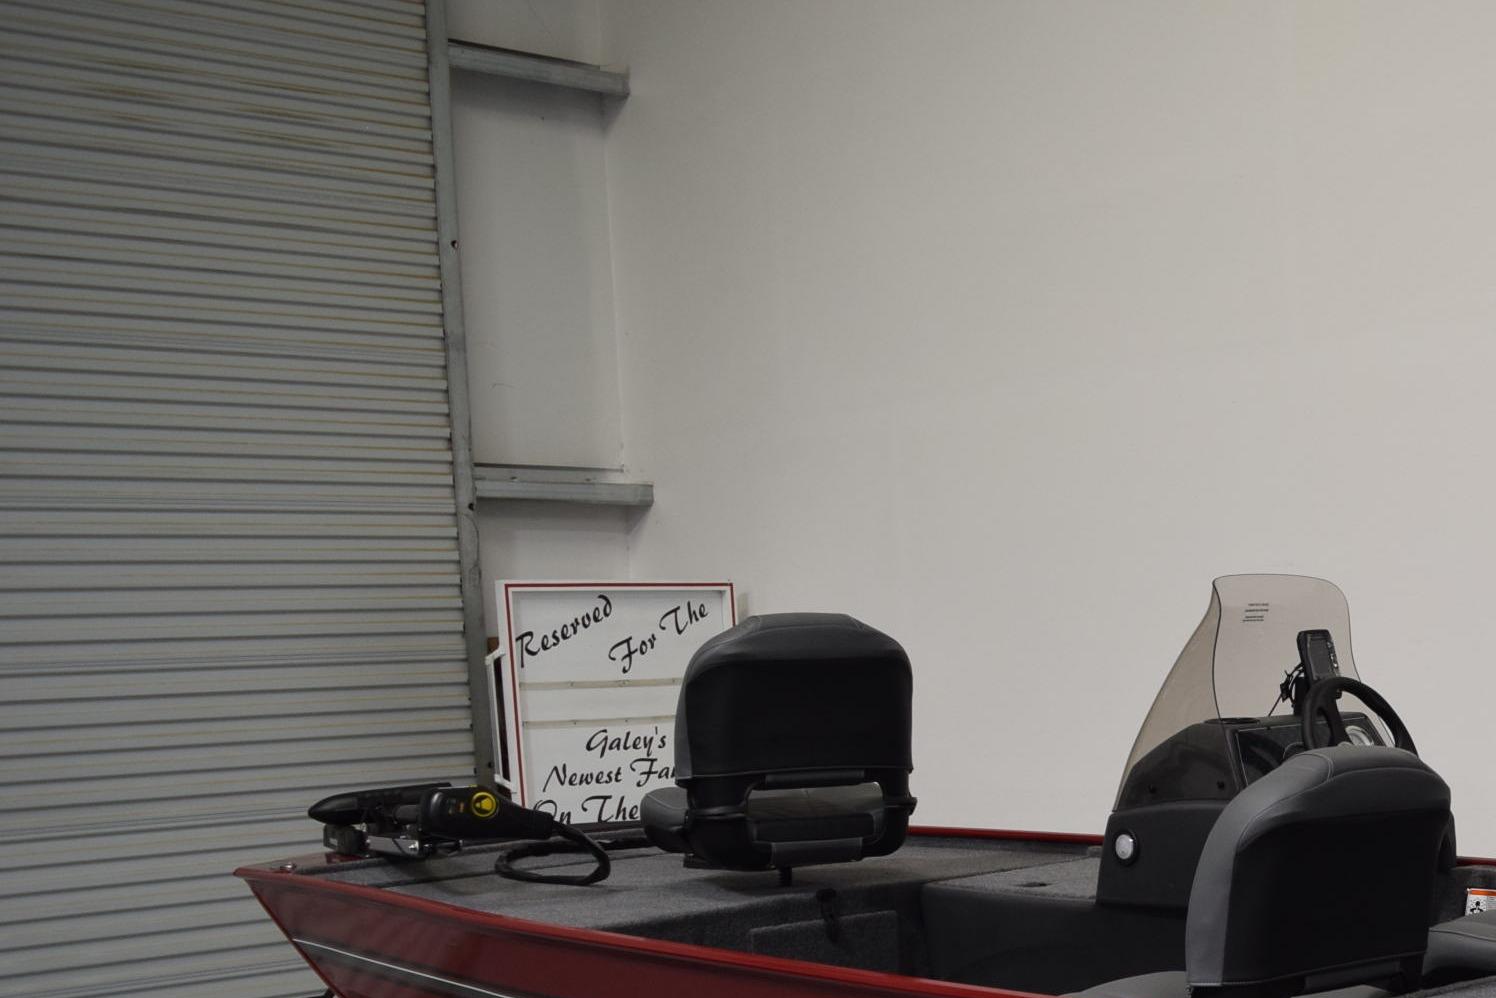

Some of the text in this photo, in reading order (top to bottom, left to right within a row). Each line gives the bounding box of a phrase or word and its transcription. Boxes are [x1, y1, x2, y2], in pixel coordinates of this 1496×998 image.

[515, 594, 613, 669] Reserved
[608, 601, 708, 674] For The
[585, 726, 667, 758] Galey's
[543, 763, 622, 793] Newest
[581, 795, 639, 823] The
